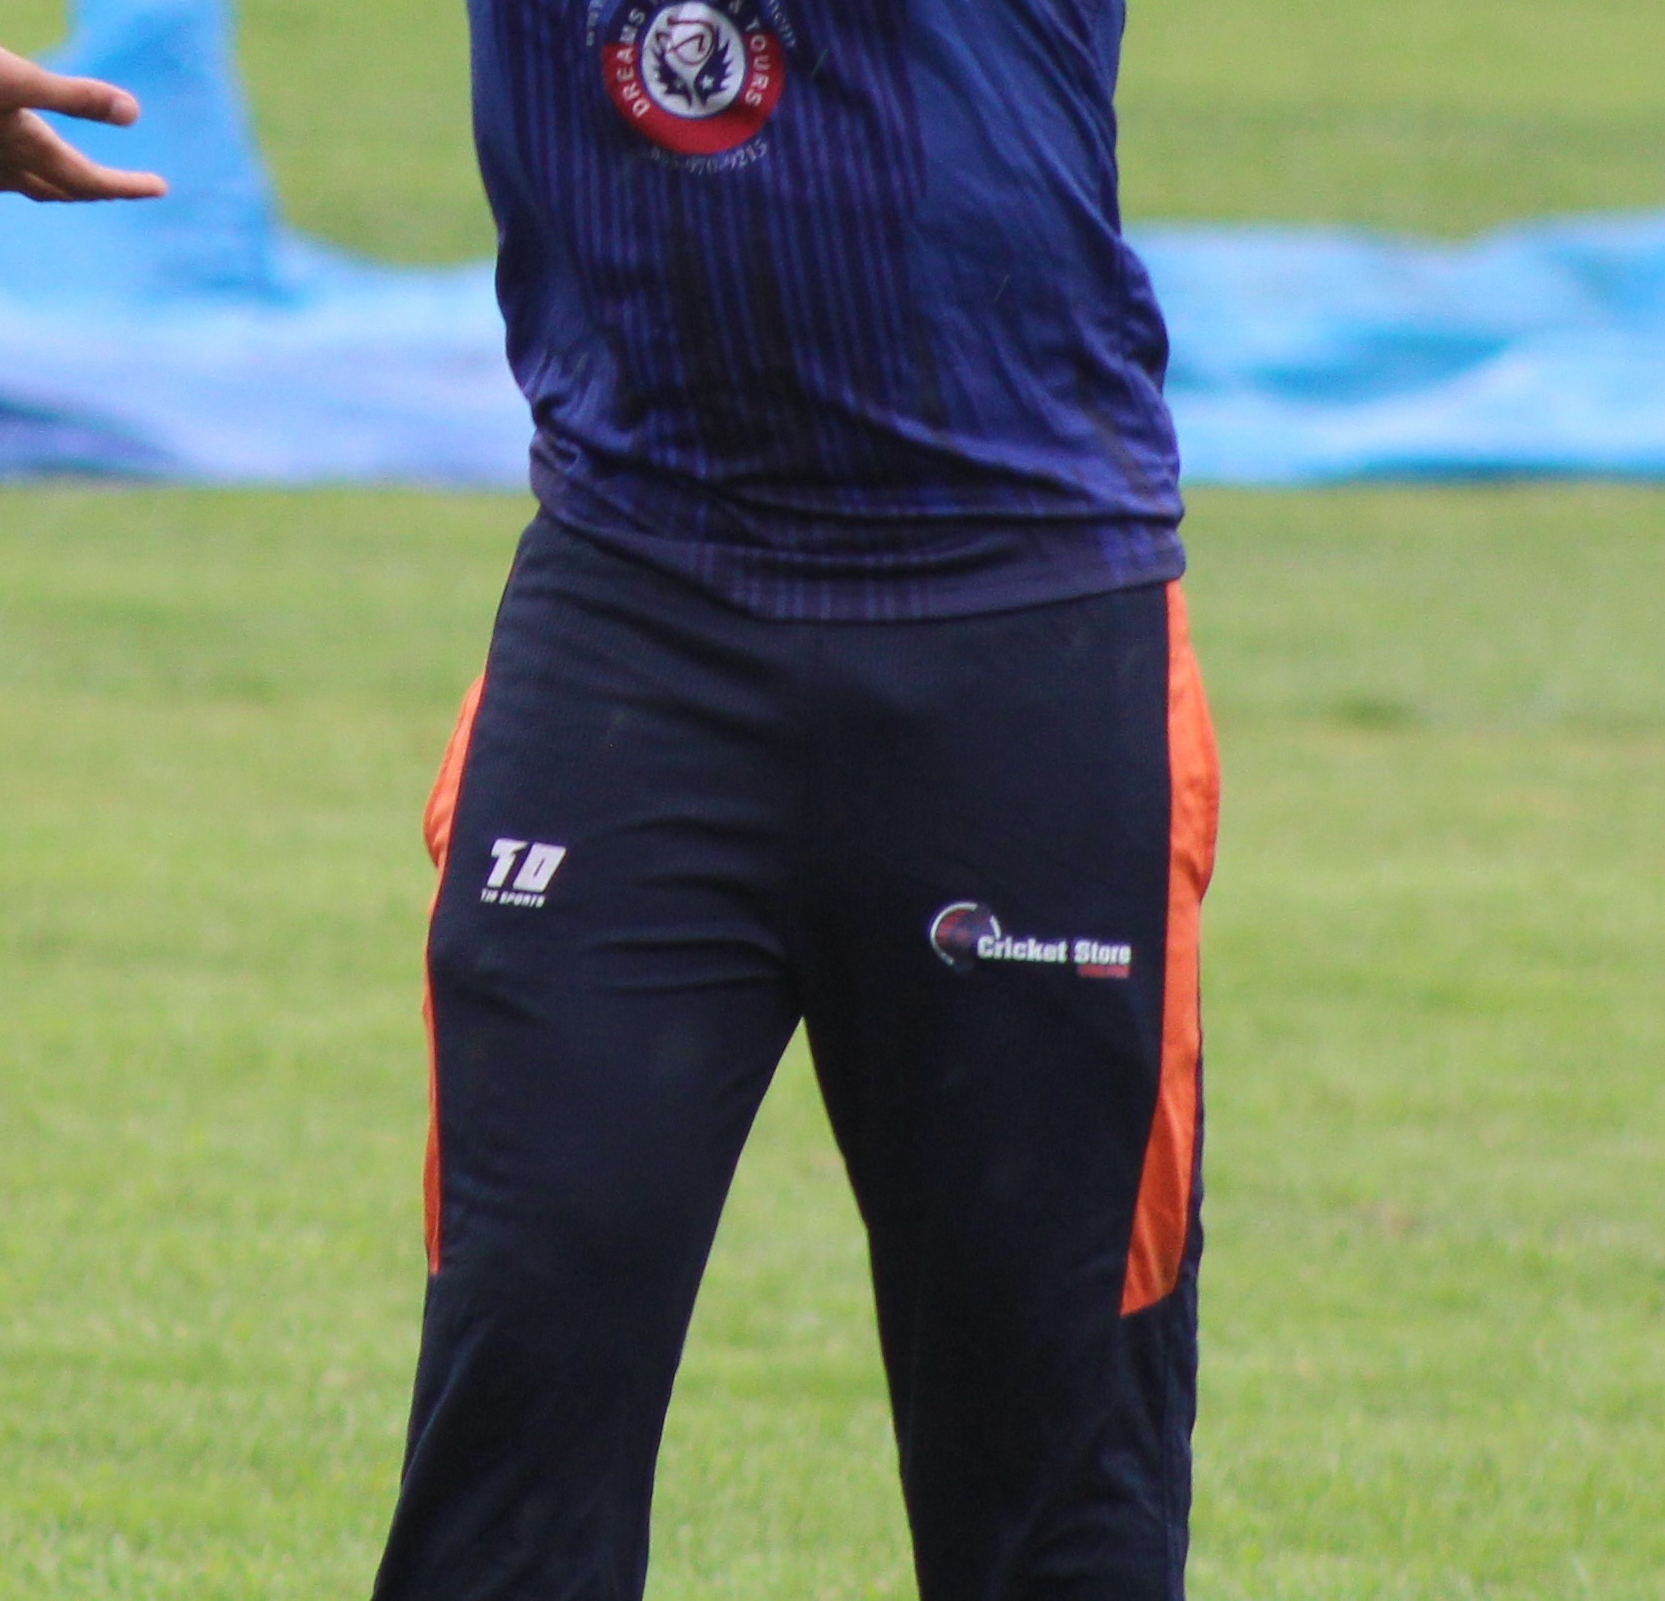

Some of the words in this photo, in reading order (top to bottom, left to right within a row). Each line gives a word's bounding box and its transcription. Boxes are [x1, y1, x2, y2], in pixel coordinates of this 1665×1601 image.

[616, 6, 652, 119] DREAMS
[745, 16, 772, 107] TOURS
[499, 890, 546, 908] SPORTS
[976, 934, 1069, 964] Cricket
[1073, 938, 1132, 965] Store
